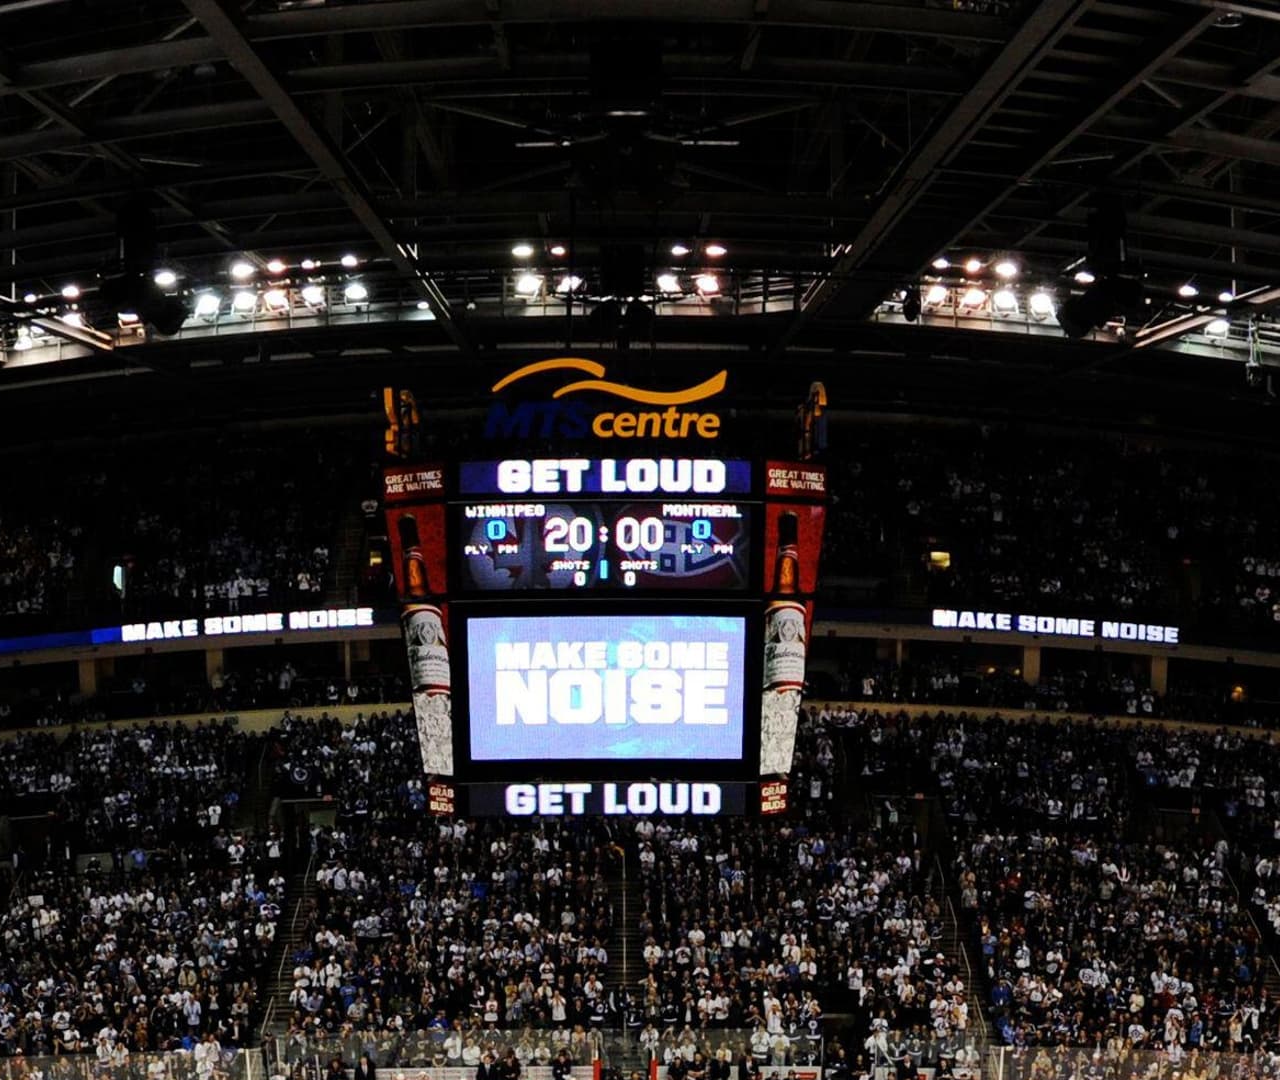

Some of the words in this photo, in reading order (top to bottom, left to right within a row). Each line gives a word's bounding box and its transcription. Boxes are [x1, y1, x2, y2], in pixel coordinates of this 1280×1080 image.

[484, 402, 592, 438] MTS
[592, 406, 720, 438] centre
[385, 473, 414, 485] GREAT
[416, 470, 442, 481] TIMES
[497, 459, 590, 493] GET
[600, 459, 726, 493] LOUD
[768, 468, 798, 480] GREAT
[800, 471, 824, 482] TIMES
[386, 483, 405, 493] ARE
[769, 478, 788, 488] ARE
[465, 505, 545, 517] WINNIPEG
[662, 504, 742, 517] MONTREAL
[544, 516, 664, 552] 20:00
[464, 545, 489, 555] PLY
[681, 544, 704, 554] PLY
[552, 560, 590, 570] SHOTS
[620, 560, 658, 570] SHOTS
[121, 619, 198, 642] MAKE
[204, 613, 283, 635] SOME
[289, 607, 374, 630] NOISE
[932, 609, 1012, 631] MAKE
[1018, 614, 1094, 636] SOME
[1102, 621, 1179, 643] NOISE
[495, 641, 607, 670] MAKE
[617, 641, 728, 670] SOME
[495, 669, 729, 725] NOISE
[429, 787, 454, 798] GRAB
[761, 785, 787, 797] GRAB
[505, 783, 592, 815] GET
[604, 783, 722, 815] LOUD
[429, 802, 454, 813] BUDS
[761, 801, 786, 812] BUDS
